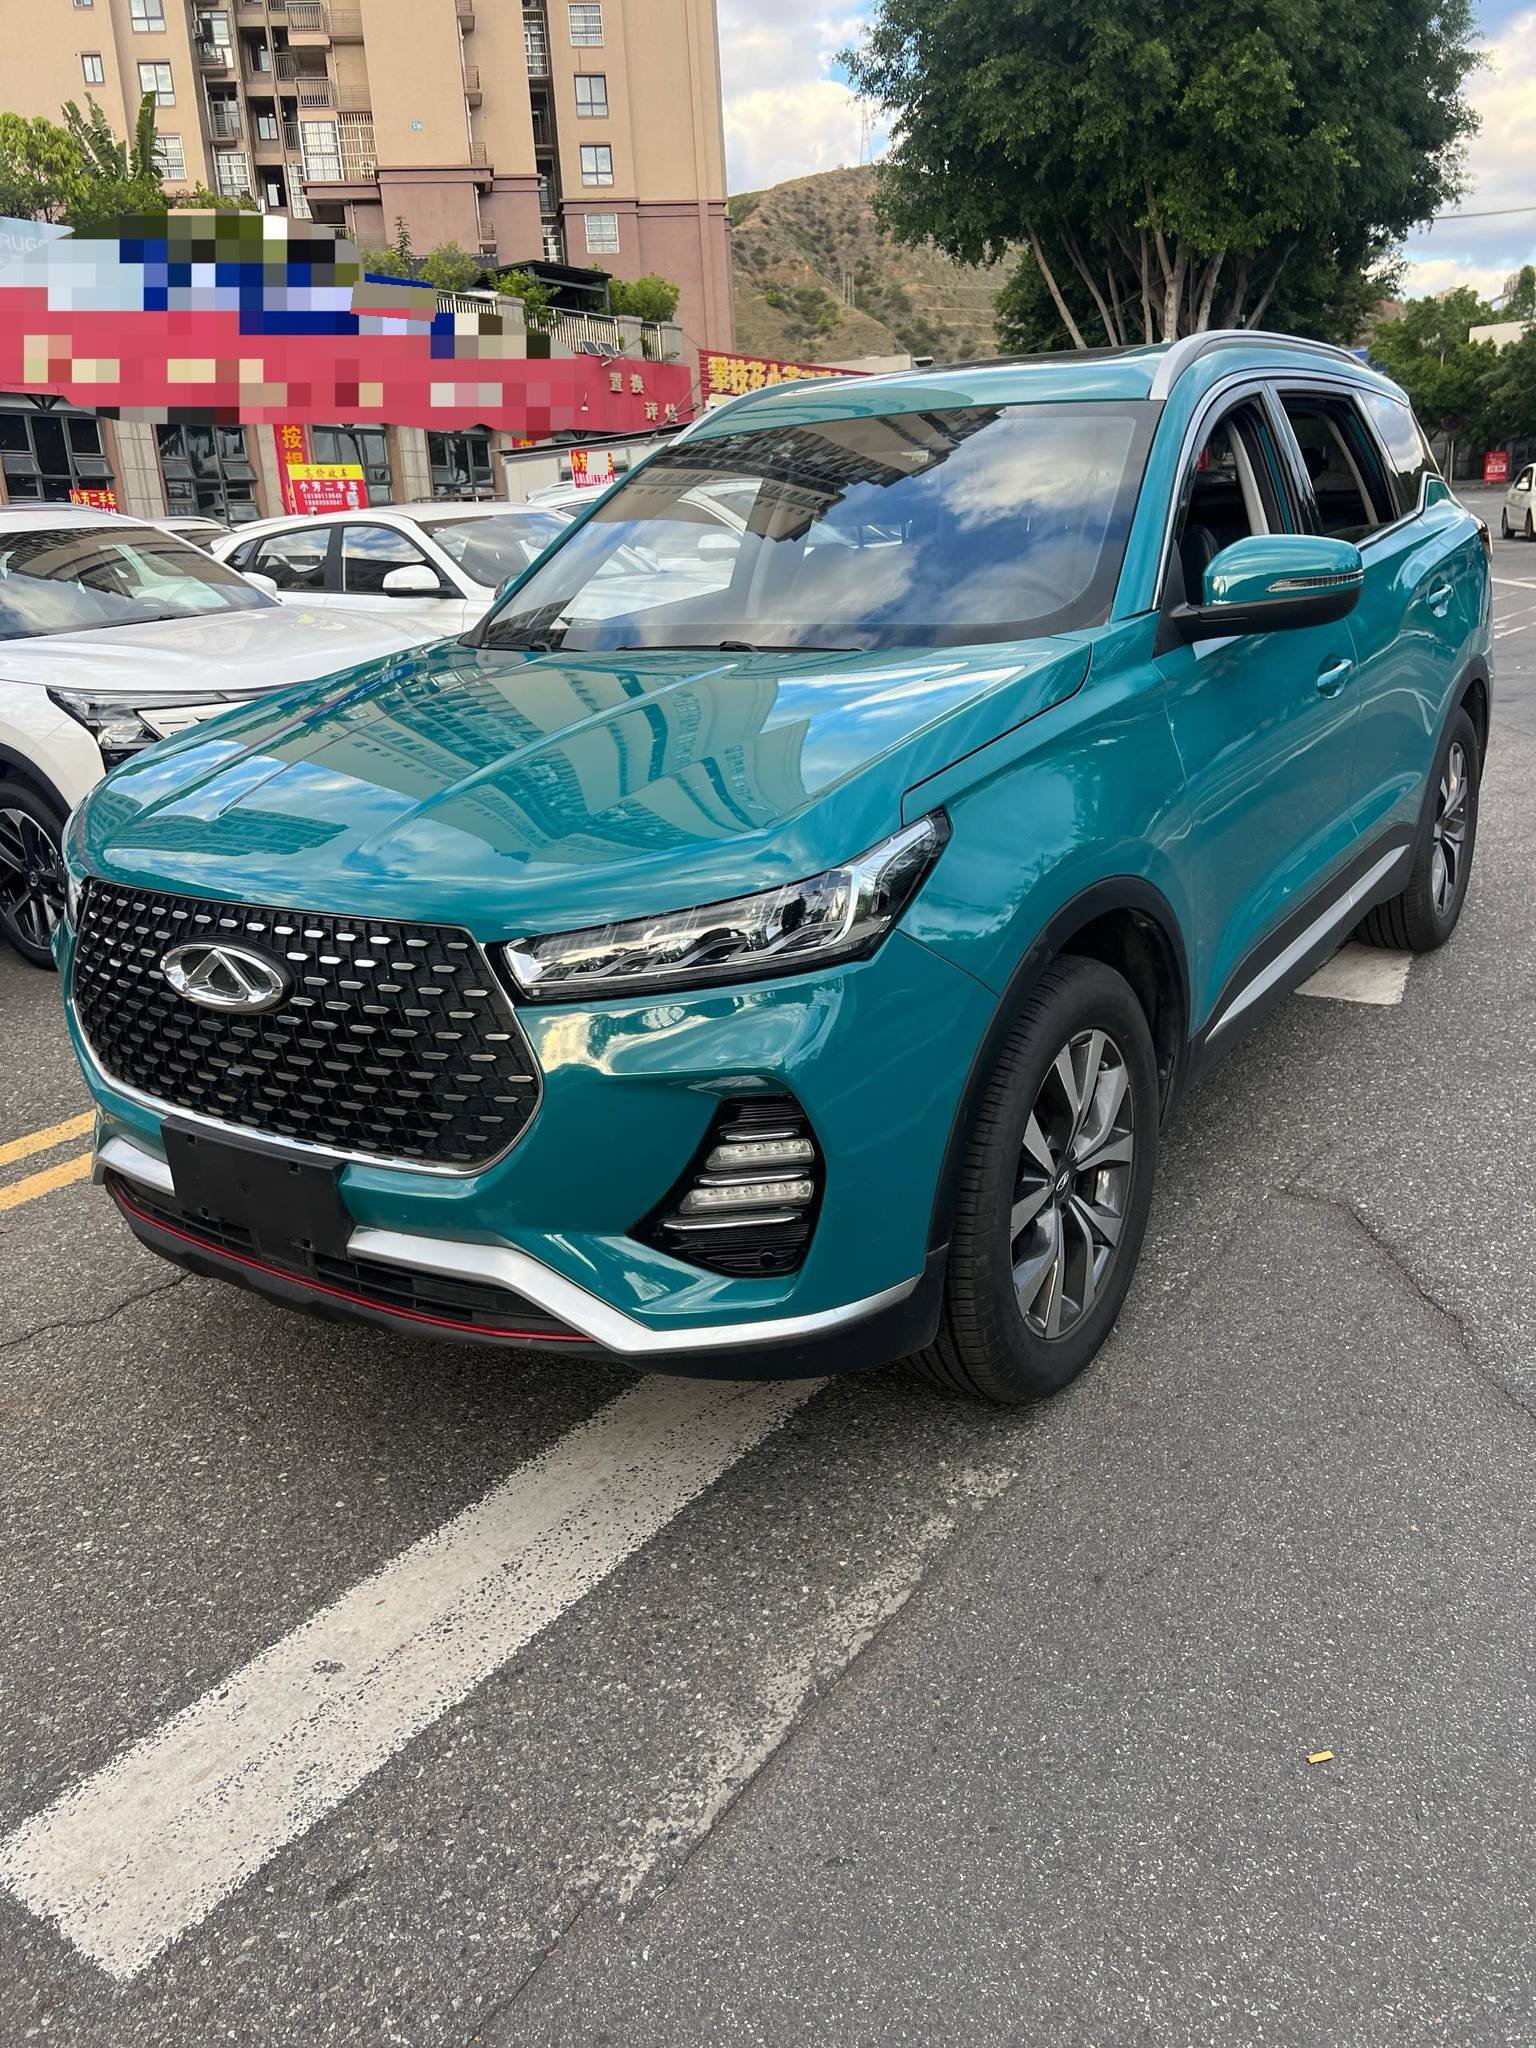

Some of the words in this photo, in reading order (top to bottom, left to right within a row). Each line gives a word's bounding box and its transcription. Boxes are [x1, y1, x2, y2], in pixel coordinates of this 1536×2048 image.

[609, 372, 644, 394] 置换
[645, 402, 678, 423] 评估
[300, 481, 358, 492] 小芳二手车
[72, 491, 116, 507] 小芳二手车
